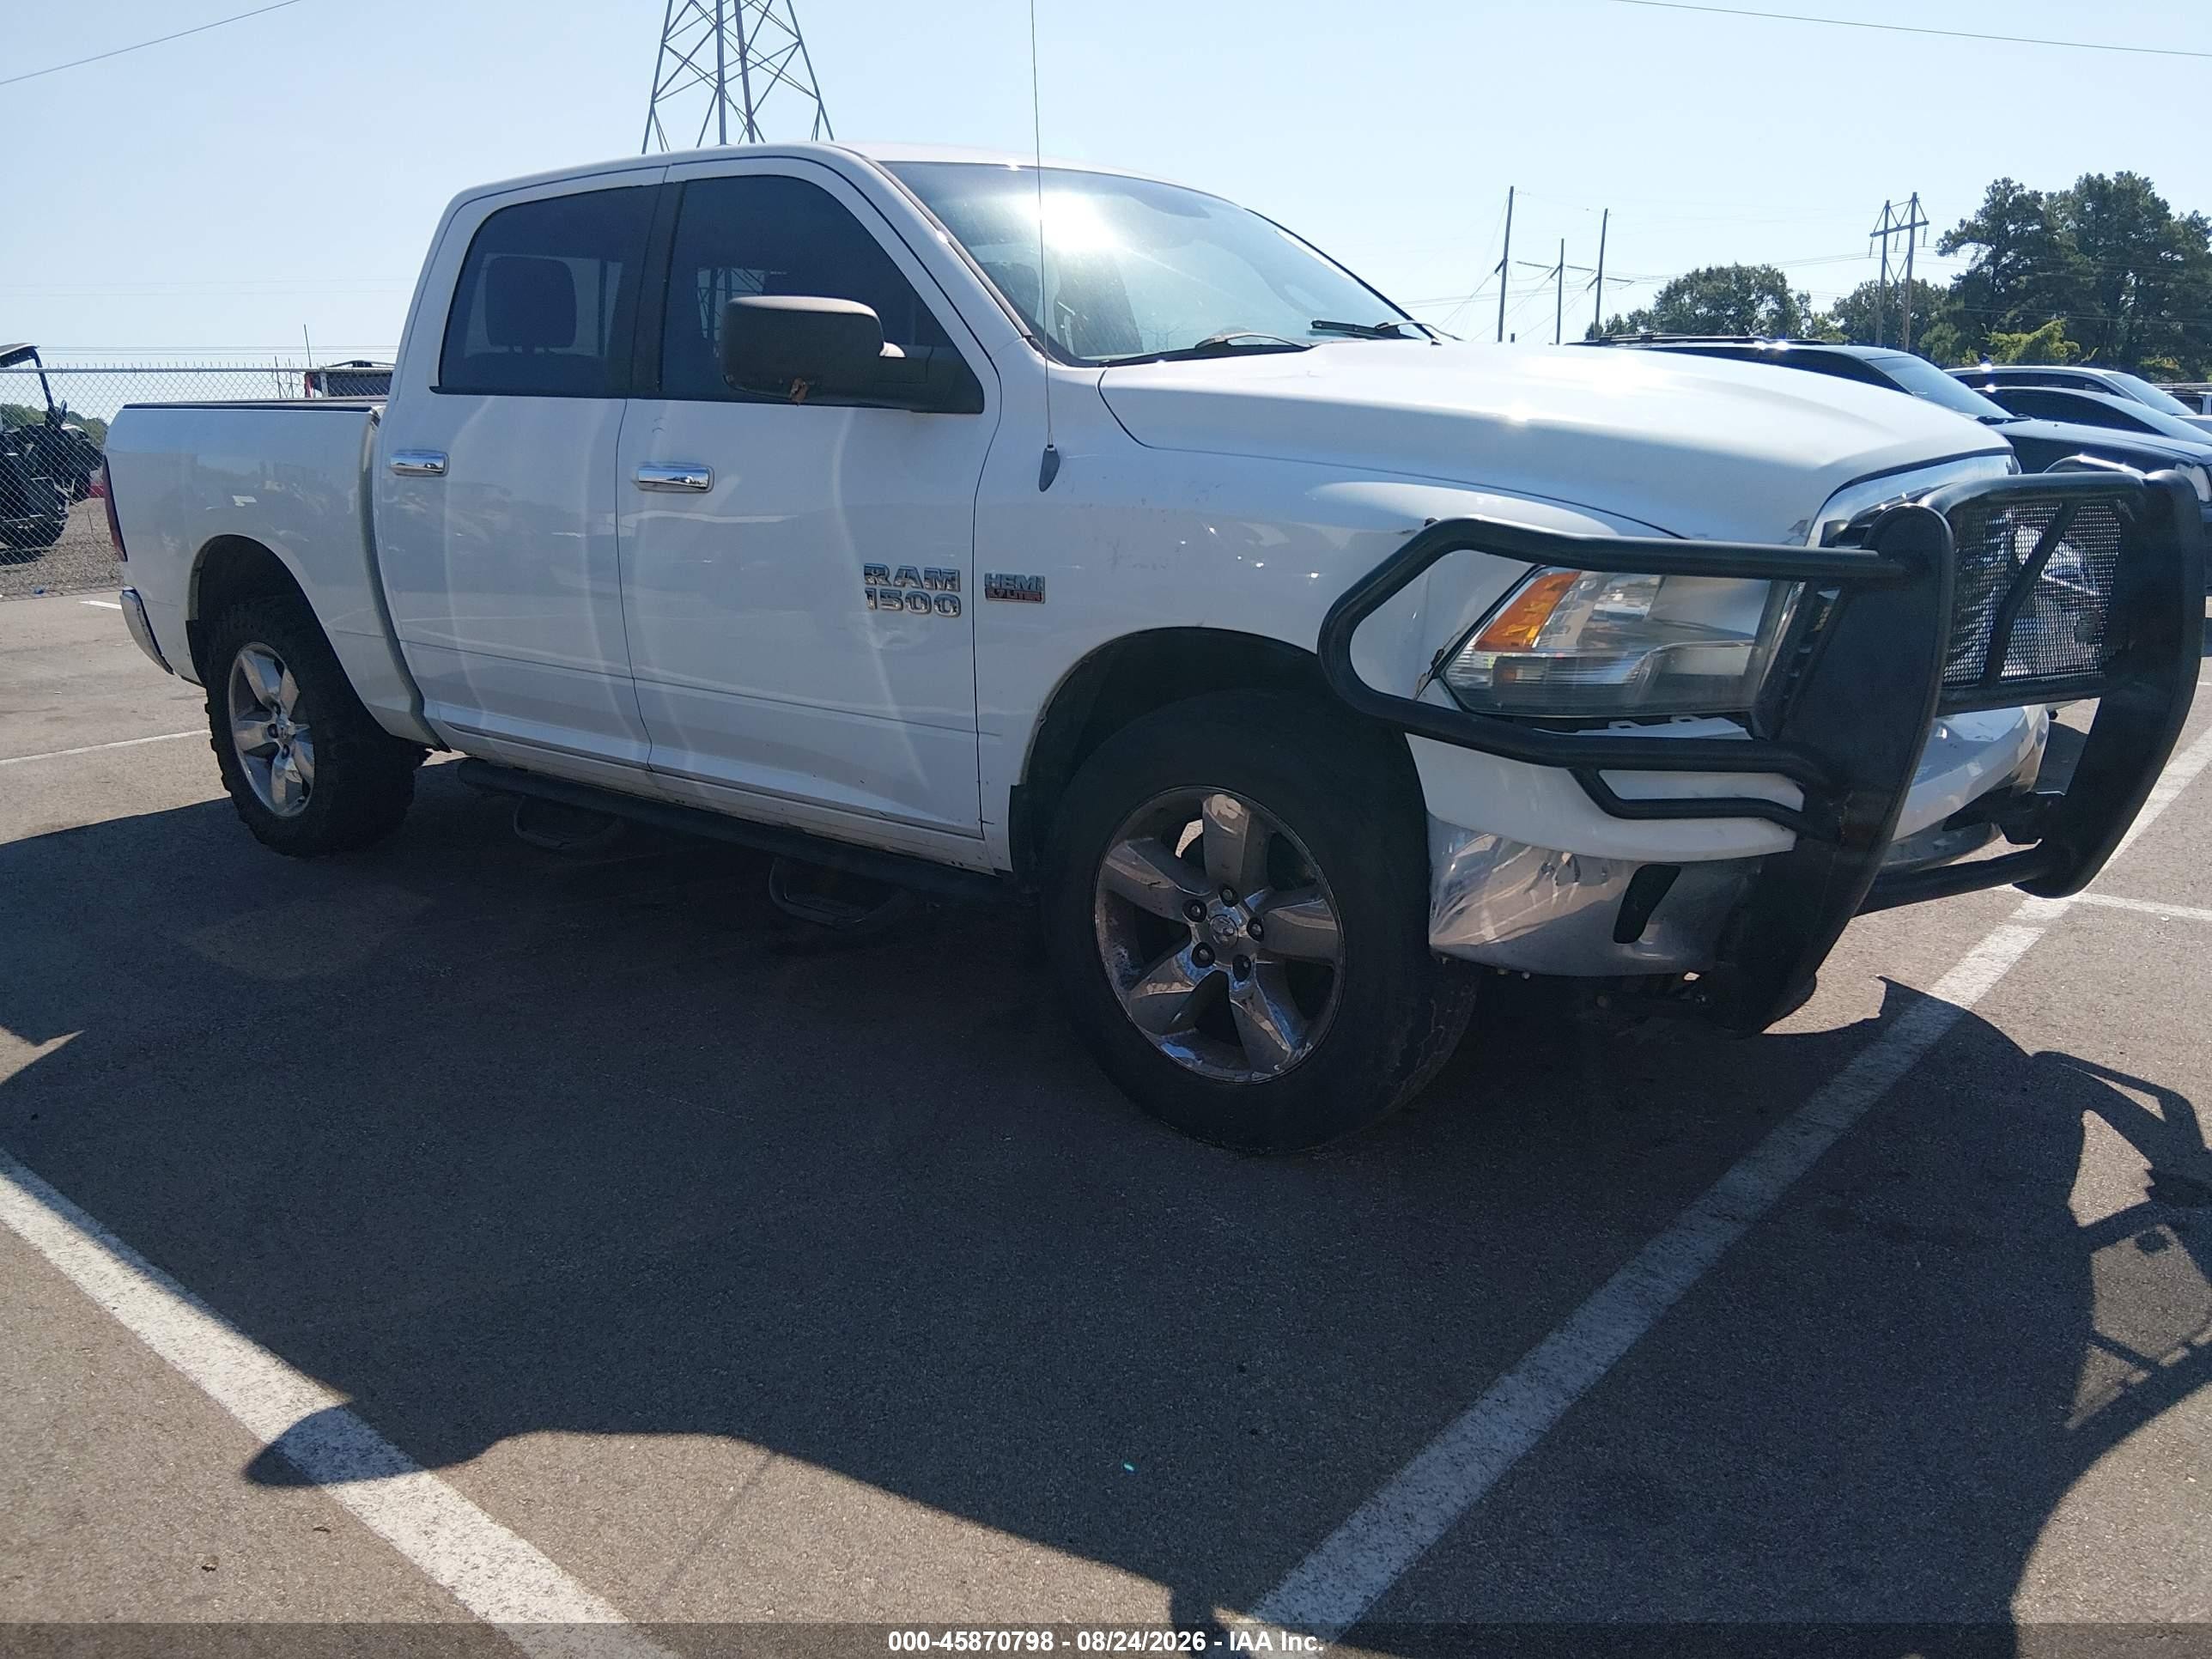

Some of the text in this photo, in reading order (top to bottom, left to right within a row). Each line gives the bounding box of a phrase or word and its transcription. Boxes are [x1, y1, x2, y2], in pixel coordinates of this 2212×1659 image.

[864, 563, 961, 592] RAM
[985, 573, 1045, 592] HEMI
[865, 587, 962, 617] 1500
